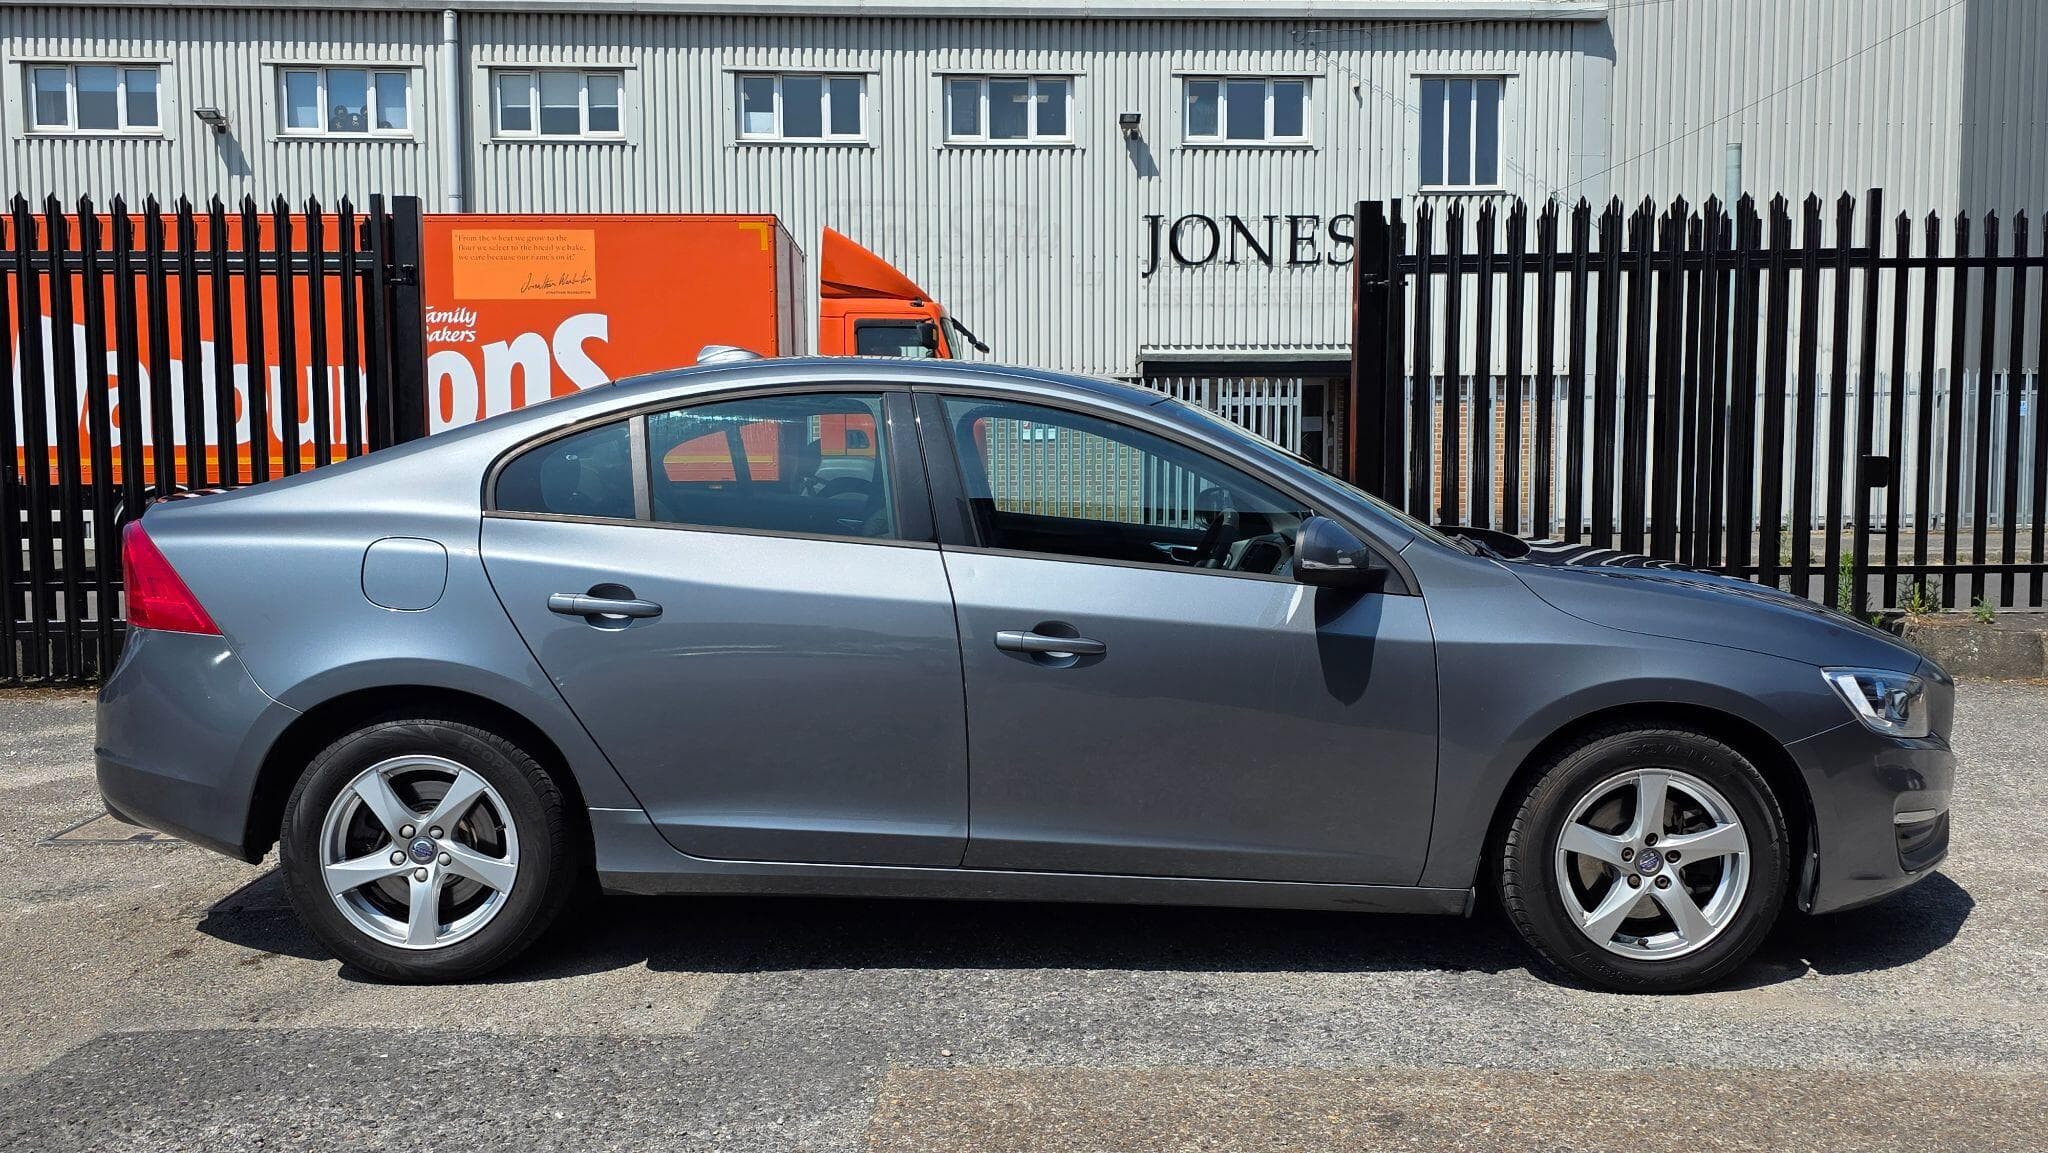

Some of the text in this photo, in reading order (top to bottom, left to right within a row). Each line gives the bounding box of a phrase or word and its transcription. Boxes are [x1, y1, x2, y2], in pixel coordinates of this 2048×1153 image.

[478, 233, 490, 242] the
[527, 236, 545, 244] grow
[547, 233, 555, 242] to
[556, 233, 567, 242] the
[1142, 214, 1354, 278] JONES
[458, 243, 475, 252] flour
[489, 243, 510, 252] select
[511, 243, 520, 252] to
[521, 243, 532, 252] the
[487, 253, 516, 261] because
[426, 306, 477, 327] amily
[426, 326, 477, 342] akers
[12, 313, 611, 446] abuons
